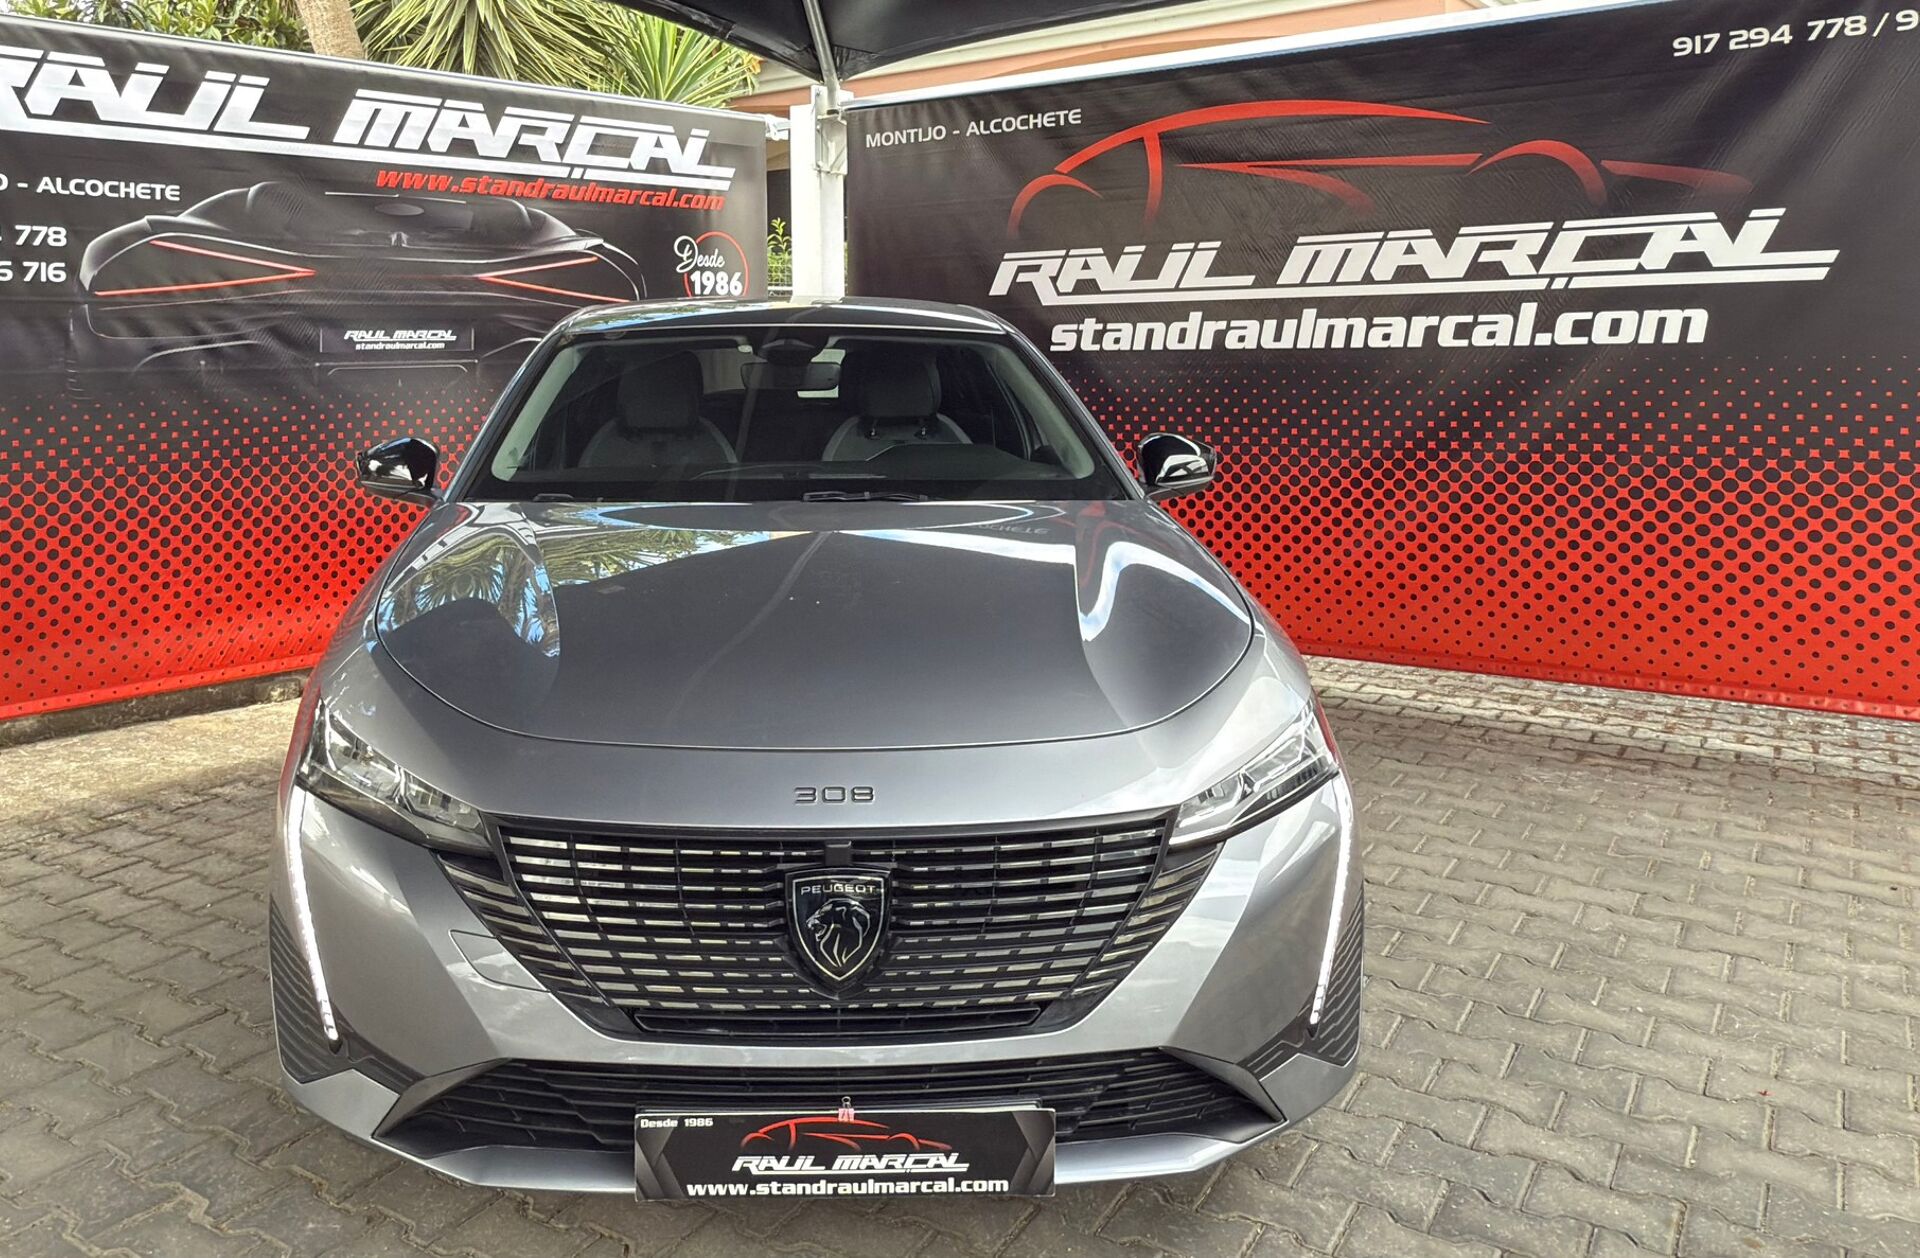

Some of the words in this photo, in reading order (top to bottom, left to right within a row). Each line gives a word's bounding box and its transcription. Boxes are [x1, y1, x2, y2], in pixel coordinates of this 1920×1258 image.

[1672, 33, 1721, 57] 917
[1728, 24, 1793, 50] 294
[1807, 15, 1867, 41] 778
[1872, 12, 1890, 37] /
[866, 125, 947, 148] MONTIJO
[966, 108, 1082, 137] ALCOCHETE
[36, 176, 181, 201] ALCOCHETE
[376, 170, 726, 211] www.standraulmarcal.com
[15, 225, 67, 247] 778
[674, 235, 725, 273] Desde
[22, 262, 67, 282] 716
[690, 270, 743, 296] 1986
[988, 240, 1256, 305] RAUL
[344, 330, 391, 341] RAUL
[1050, 302, 1708, 352] standraulmarcal.com
[355, 342, 445, 351] standraulmarcal.com
[794, 786, 874, 804] 308
[801, 883, 876, 895] PEUGEOT
[640, 1118, 678, 1128] Desde
[684, 1117, 713, 1127] 1986
[731, 1155, 826, 1174] RAUL
[687, 1176, 1009, 1197] www.standraulmarcal.com
